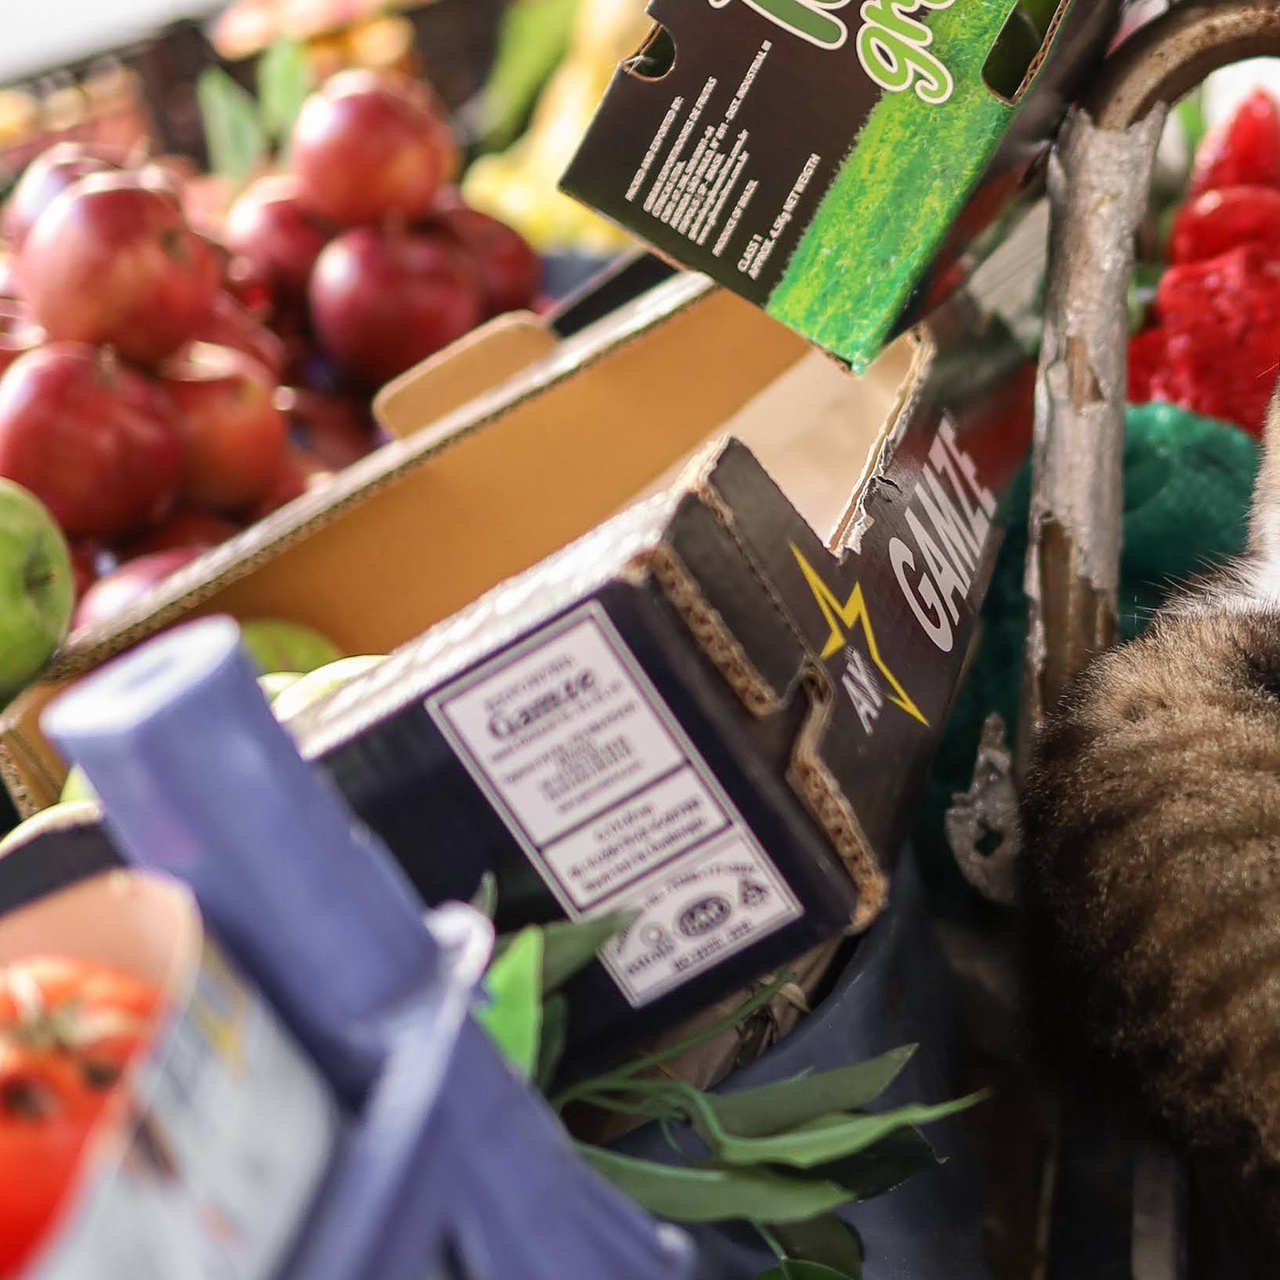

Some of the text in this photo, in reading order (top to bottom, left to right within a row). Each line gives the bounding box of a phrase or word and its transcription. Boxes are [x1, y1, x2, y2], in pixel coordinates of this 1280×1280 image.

[694, 75, 718, 110] FRUTAS
[735, 48, 767, 100] INDUSTRIAL
[623, 168, 646, 202] PACKED
[648, 108, 677, 153] EXPORTED
[711, 177, 759, 257] PRODUCE OF BRAZIL
[746, 235, 776, 280] APPROX.
[768, 209, 792, 241] 4.5Kg
[782, 190, 800, 212] NET
[735, 232, 763, 273] CLASS 1
